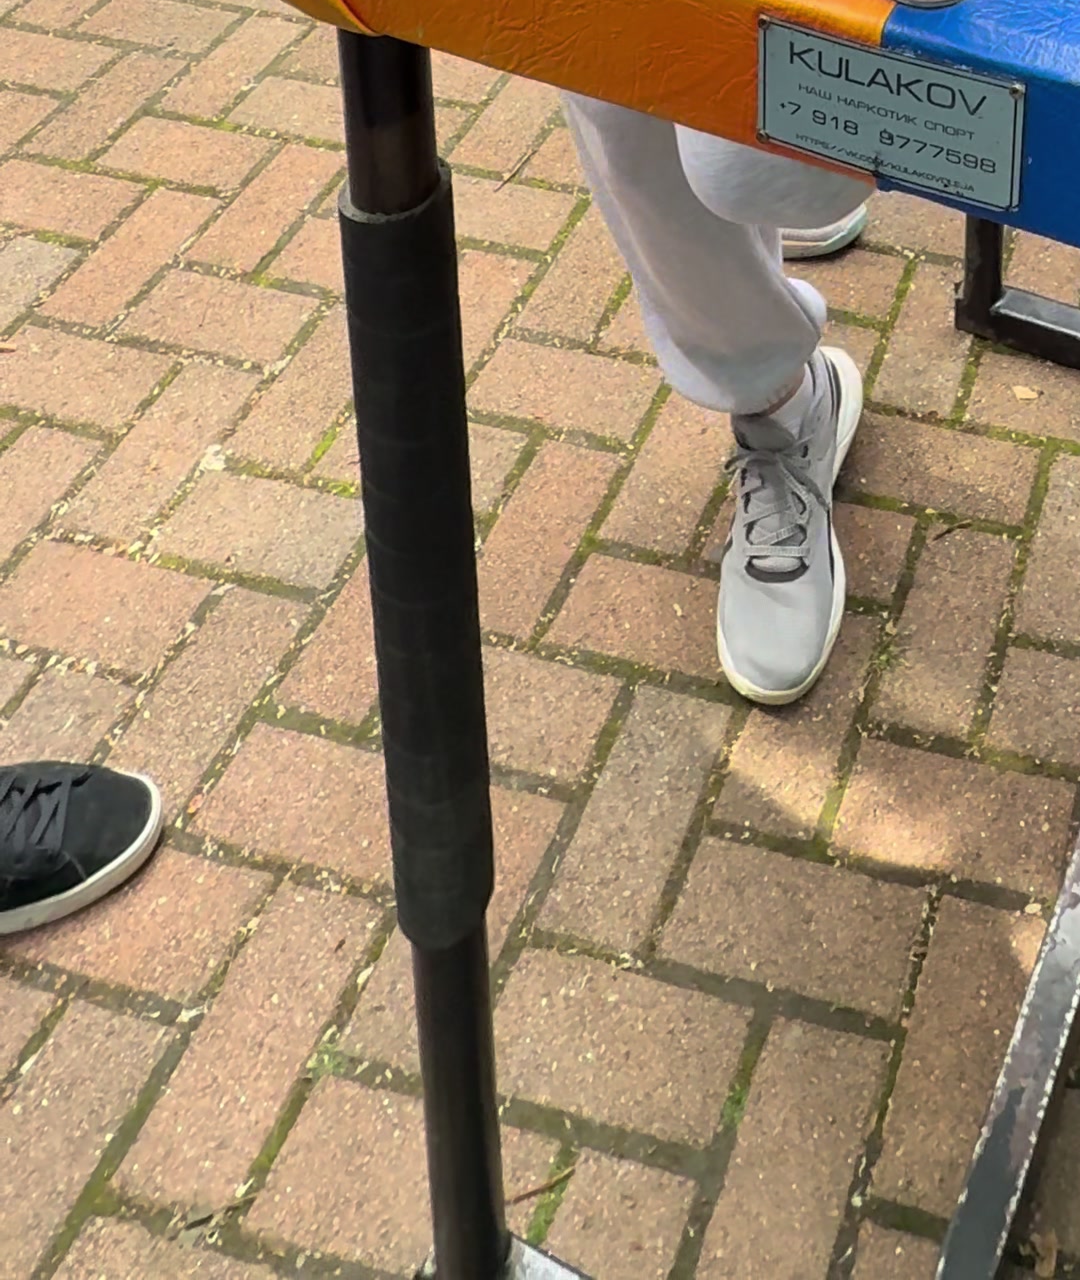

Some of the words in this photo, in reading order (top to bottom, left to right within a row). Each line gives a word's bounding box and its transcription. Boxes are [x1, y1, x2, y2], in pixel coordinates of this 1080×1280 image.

[789, 41, 987, 117] KULAKOV
[779, 101, 802, 116] +7
[812, 110, 859, 136] 918
[798, 83, 832, 102] НАШ
[836, 94, 918, 126] НАРКОТИК
[924, 119, 976, 141] СПОРТ
